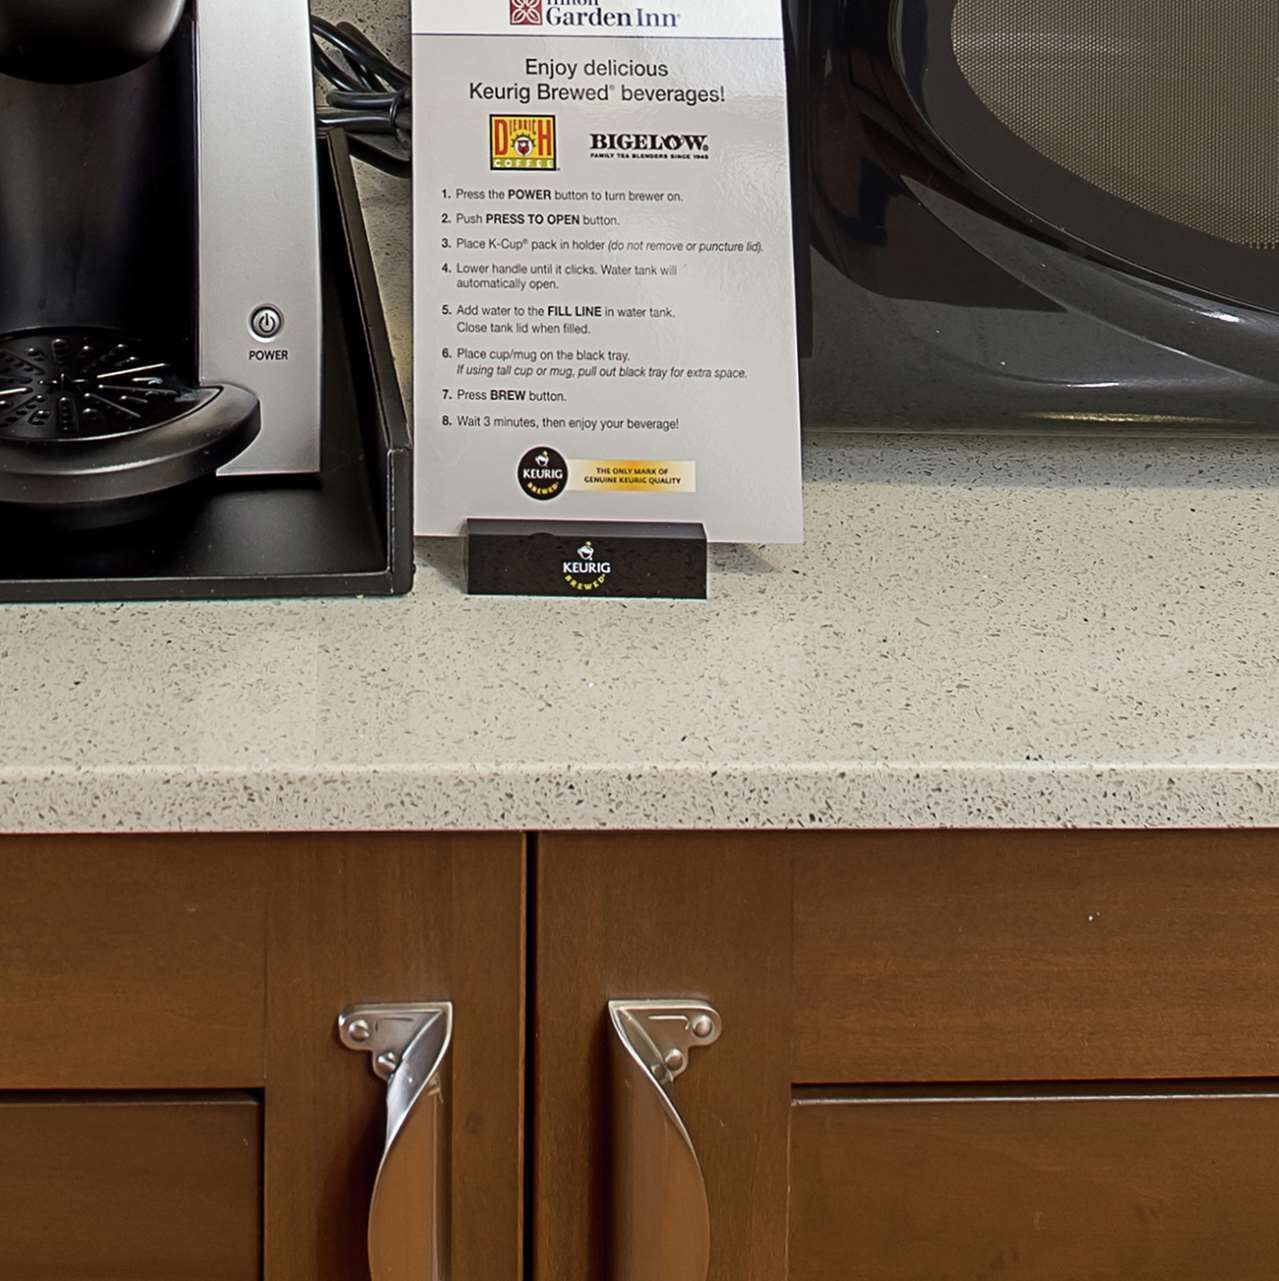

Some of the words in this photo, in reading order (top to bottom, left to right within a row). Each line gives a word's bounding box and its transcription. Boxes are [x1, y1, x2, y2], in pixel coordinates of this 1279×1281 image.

[546, 8, 632, 27] Garden
[525, 59, 578, 79] Enjoy
[584, 60, 669, 77] delicious
[469, 83, 530, 103] Keurig
[622, 84, 725, 105] beverages!
[494, 159, 553, 168] COFFEE
[442, 189, 451, 199] 1.
[456, 189, 485, 199] Press
[489, 189, 505, 199] the
[508, 189, 551, 200] POWER
[555, 190, 588, 201] button
[592, 191, 601, 201] to
[605, 191, 625, 201] turn
[629, 191, 664, 201] brewer
[667, 192, 683, 201] on.
[441, 213, 451, 224] 2.
[456, 213, 483, 224] Push
[486, 214, 525, 224] PRESS
[528, 214, 543, 224] TO
[547, 214, 580, 225] OPEN
[583, 215, 620, 226] button.
[441, 239, 451, 249] 3.
[456, 238, 485, 249] Place
[532, 239, 557, 251] pack
[560, 240, 569, 249] in
[572, 240, 605, 250] holder
[608, 240, 624, 253] (do
[627, 241, 643, 251] not
[646, 242, 683, 251] remove
[686, 242, 696, 251] or
[698, 242, 744, 253] puncture
[747, 241, 763, 253] lid).
[441, 263, 451, 273] 4.
[457, 263, 488, 274] Lower
[492, 264, 527, 274] handle
[530, 264, 553, 274] until
[556, 264, 562, 274] it
[565, 265, 598, 275] clicks.
[601, 265, 631, 275] Water
[634, 265, 657, 276] tank
[660, 265, 677, 276] will
[457, 279, 526, 291] automatically
[529, 280, 559, 291] open.
[442, 305, 452, 315] 5.
[457, 305, 478, 316] Add
[481, 307, 511, 316] water
[514, 307, 525, 316] to
[528, 306, 544, 316] the
[548, 306, 572, 316] FILL
[575, 306, 601, 317] LINE
[605, 307, 614, 317] in
[617, 308, 646, 318] water
[649, 308, 675, 318] tank.
[457, 322, 487, 333] Close
[490, 322, 513, 333] tank
[516, 322, 528, 333] lid
[532, 323, 560, 333] when
[563, 323, 591, 334] filled.
[249, 350, 288, 361] POWER
[442, 348, 452, 358] 6.
[457, 347, 486, 359] Place
[490, 349, 537, 362] cup/mug
[540, 351, 553, 360] on
[557, 349, 573, 360] the
[577, 349, 605, 361] black
[608, 351, 630, 363] tray.
[457, 364, 463, 374] If
[466, 365, 494, 377] using
[496, 365, 511, 376] tall
[514, 367, 533, 378] cup
[536, 367, 547, 376] or
[549, 367, 575, 379] mug,
[578, 367, 597, 378] pull
[599, 368, 616, 376] out
[619, 366, 645, 377] black
[648, 368, 667, 379] tray
[670, 367, 684, 377] for
[687, 368, 712, 378] extra
[714, 369, 747, 380] space.
[442, 389, 452, 400] 7.
[457, 389, 487, 400] Press
[490, 390, 526, 401] BREW
[529, 390, 567, 401] button.
[442, 415, 452, 426] 8.
[457, 416, 481, 426] Wait
[484, 416, 491, 427] 3
[494, 416, 539, 429] minutes,
[542, 417, 566, 428] then
[568, 418, 598, 431] enjoy
[600, 419, 623, 431] your
[627, 418, 679, 431] beverage!
[523, 469, 563, 479] KEURIG
[563, 562, 611, 573] KEURIG
